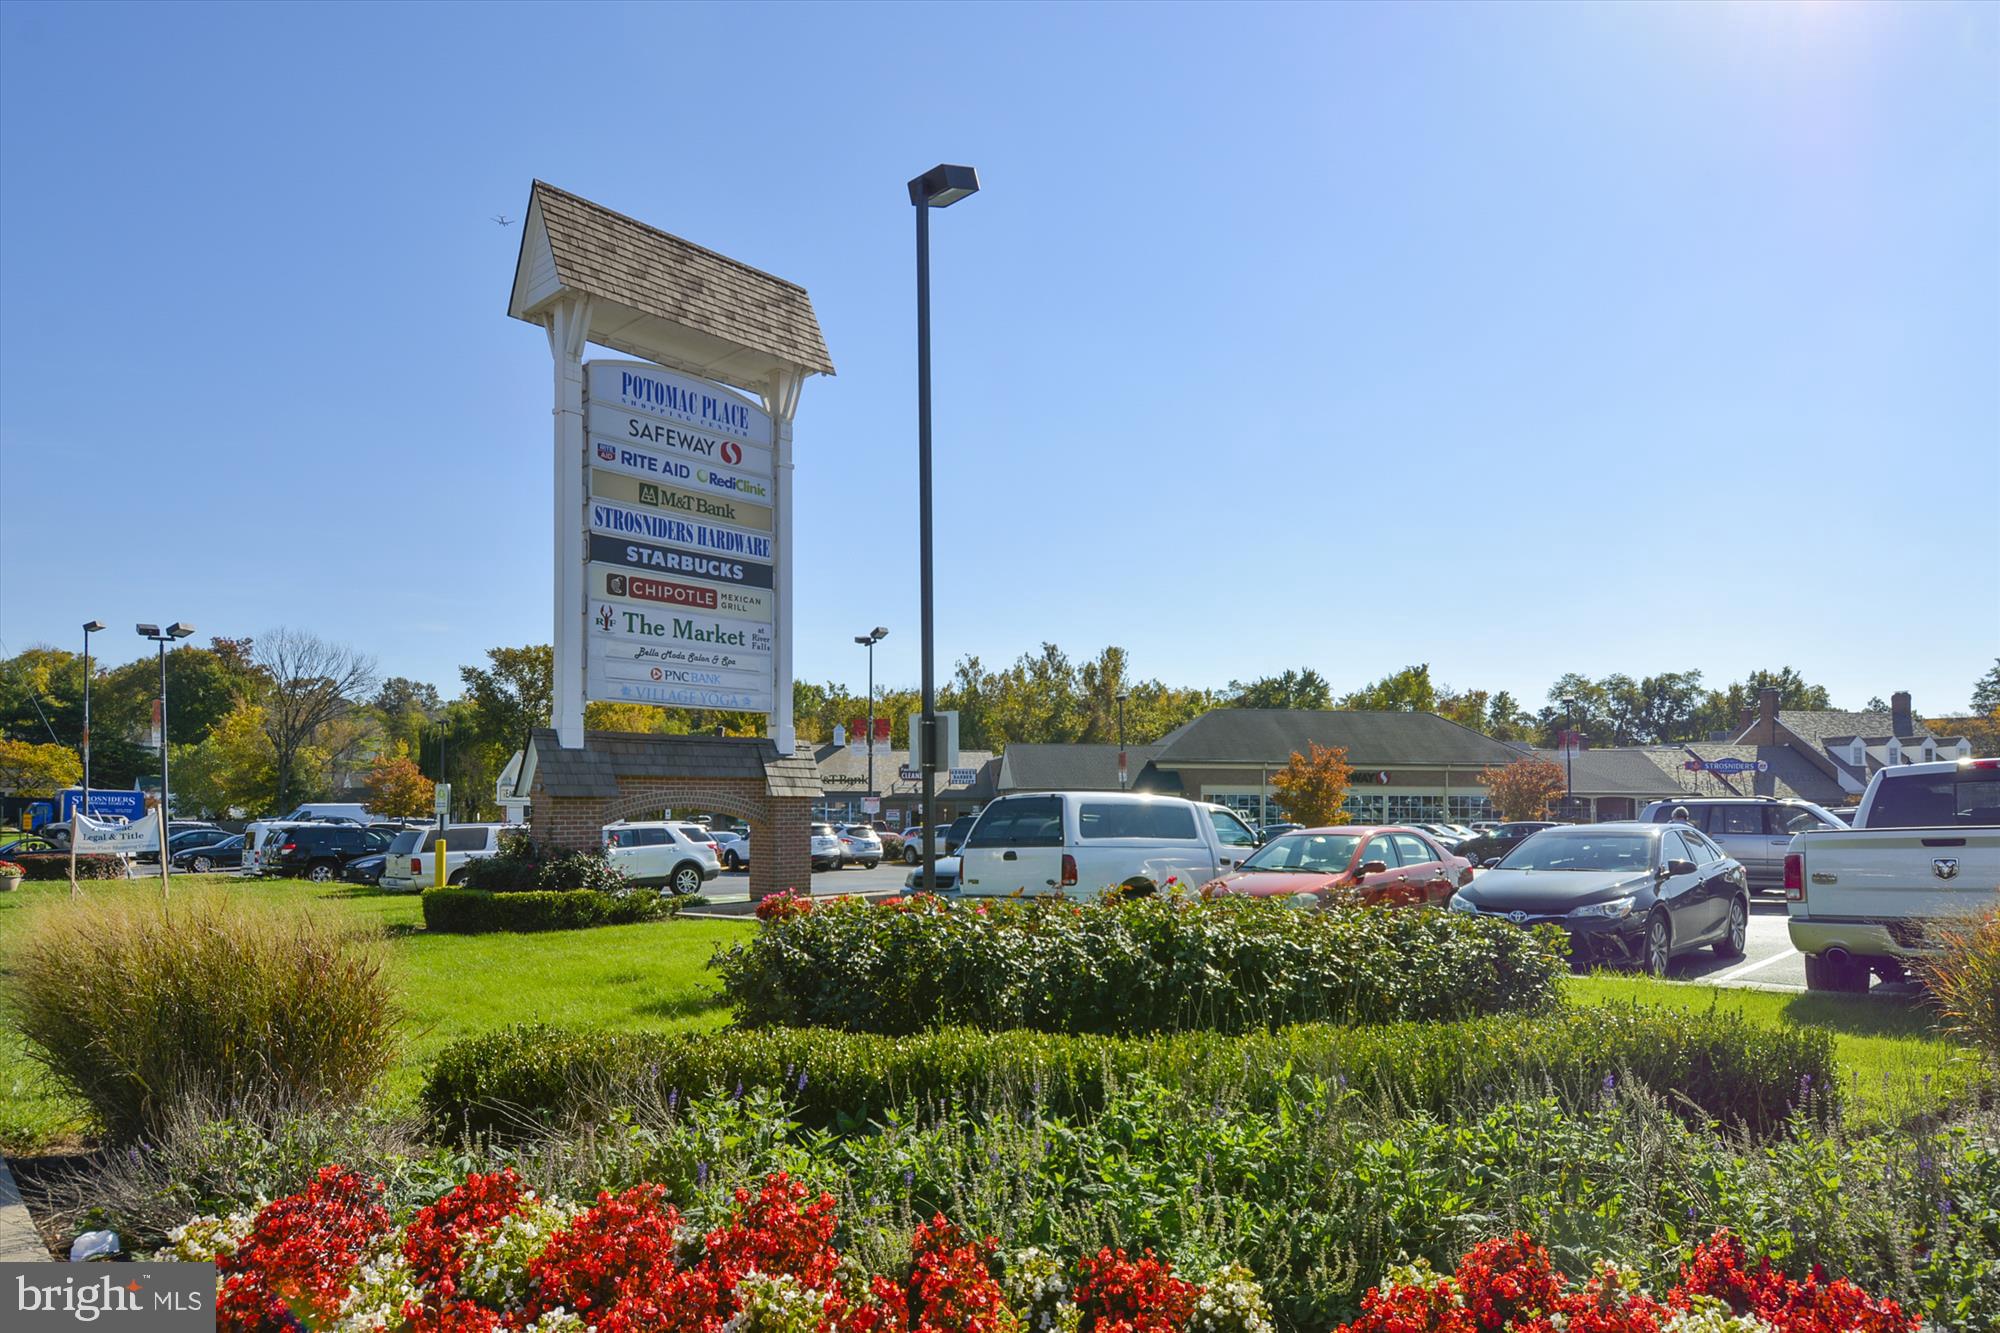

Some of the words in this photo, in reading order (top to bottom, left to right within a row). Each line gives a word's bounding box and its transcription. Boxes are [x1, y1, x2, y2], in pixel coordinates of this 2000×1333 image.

[621, 371, 698, 415] POTOMAC
[702, 395, 749, 430] PLACE
[628, 418, 716, 456] SAFEWAY
[600, 451, 614, 460] AID
[621, 450, 658, 472] RITE
[661, 460, 690, 479] AID
[709, 471, 767, 497] RediClinic
[660, 489, 695, 511] M&T
[695, 496, 736, 520] Bank
[594, 504, 694, 545] STROSNIDERS
[697, 525, 771, 558] HARDWARE
[626, 545, 744, 580] STARBUCKS
[631, 581, 715, 606] CHIPOTLE
[720, 592, 762, 606] MEXICAN
[720, 601, 748, 612] GRILL
[622, 610, 665, 637] The
[672, 617, 746, 647] Market
[751, 633, 771, 643] River
[634, 646, 660, 660] Bella
[687, 651, 711, 664] Salon
[711, 654, 720, 665] &
[721, 655, 736, 668] Spa
[751, 641, 771, 652] Falls
[636, 685, 697, 704] VILLAGE
[700, 692, 739, 708] YOGA
[1704, 762, 1755, 770] STROSNIDERS
[839, 773, 870, 786] Bank
[71, 795, 136, 806] STOSNIDERS
[83, 833, 106, 842] Legal
[108, 833, 117, 841] &
[119, 832, 145, 840] Title
